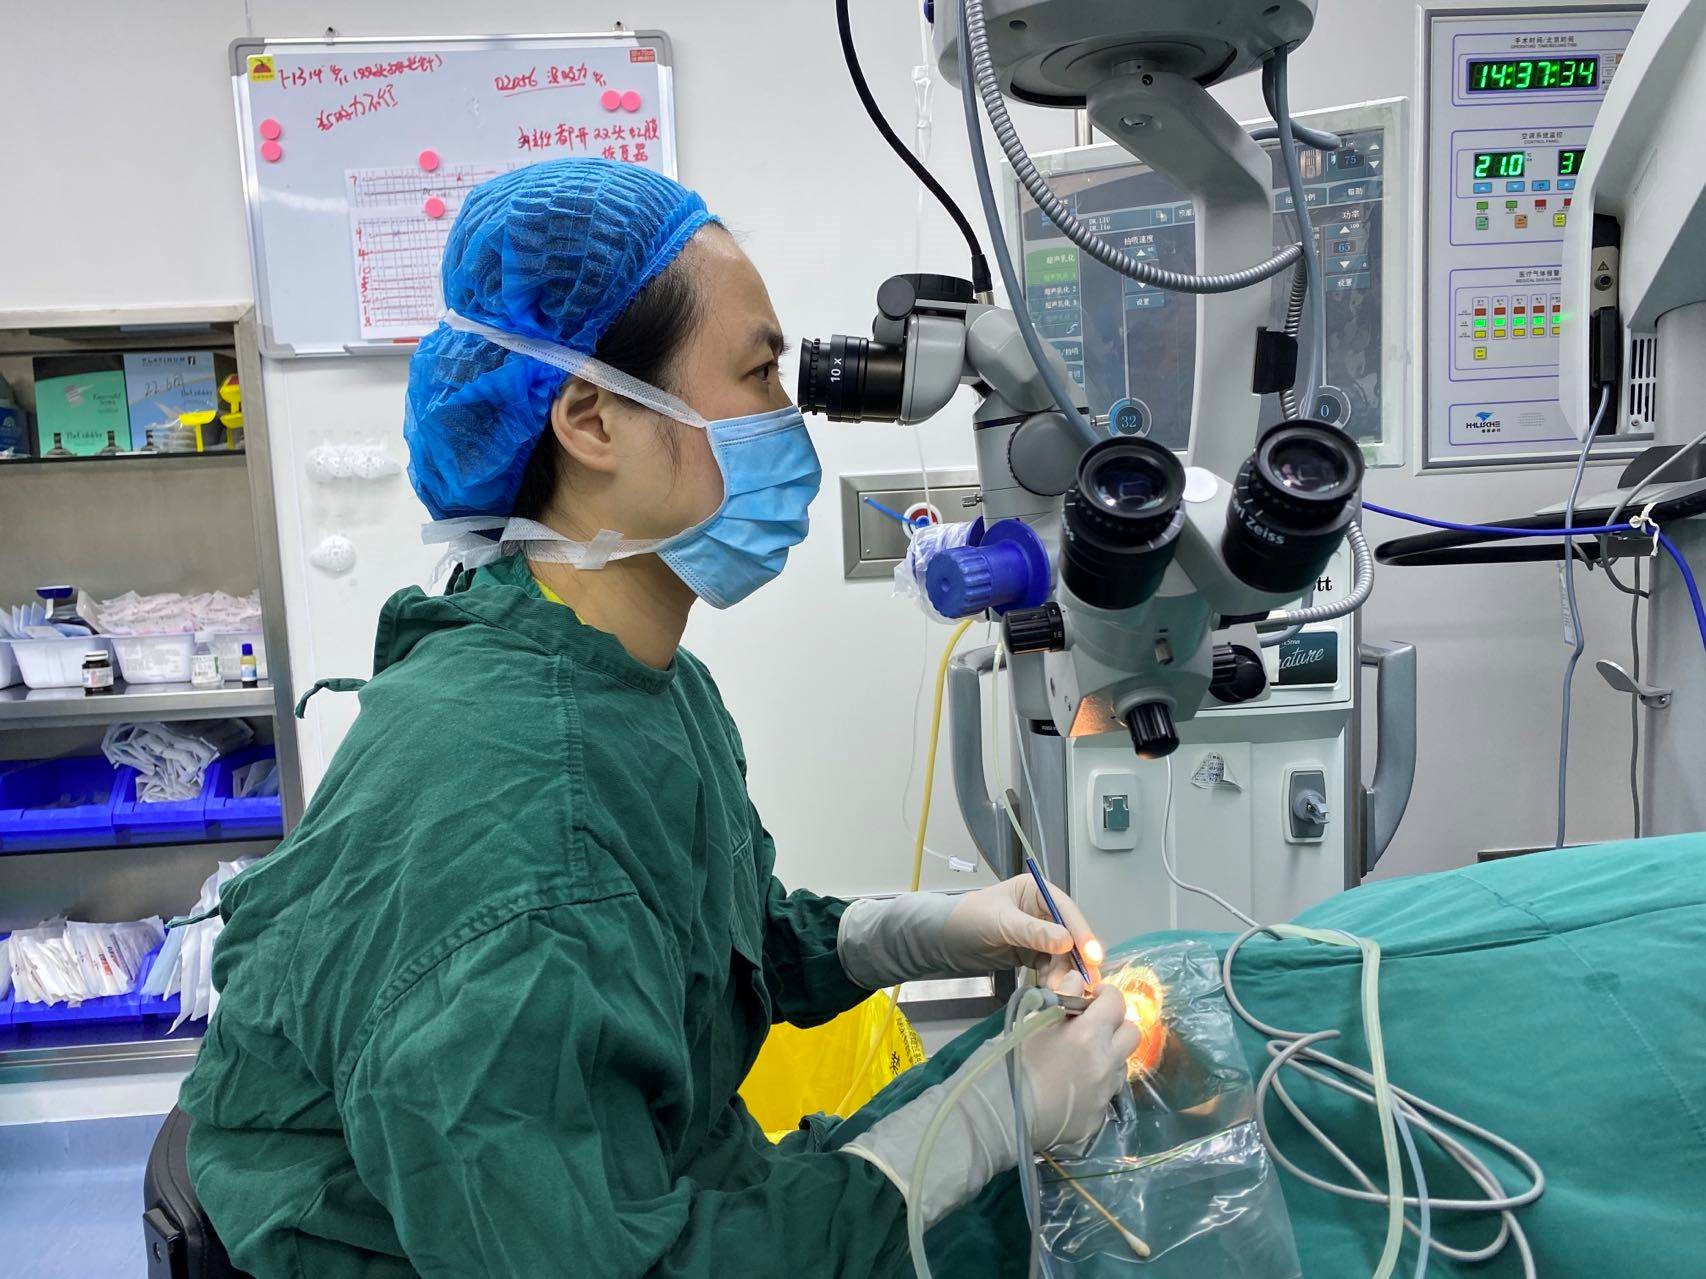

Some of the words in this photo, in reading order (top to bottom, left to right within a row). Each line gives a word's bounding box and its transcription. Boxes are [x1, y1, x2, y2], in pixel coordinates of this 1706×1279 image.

[1479, 61, 1595, 88] 14:37:34
[1475, 154, 1523, 177] 21.0
[1338, 243, 1351, 253] 65
[1320, 404, 1330, 418] 0
[1120, 415, 1137, 429] 32
[1245, 515, 1285, 545] Zeiss
